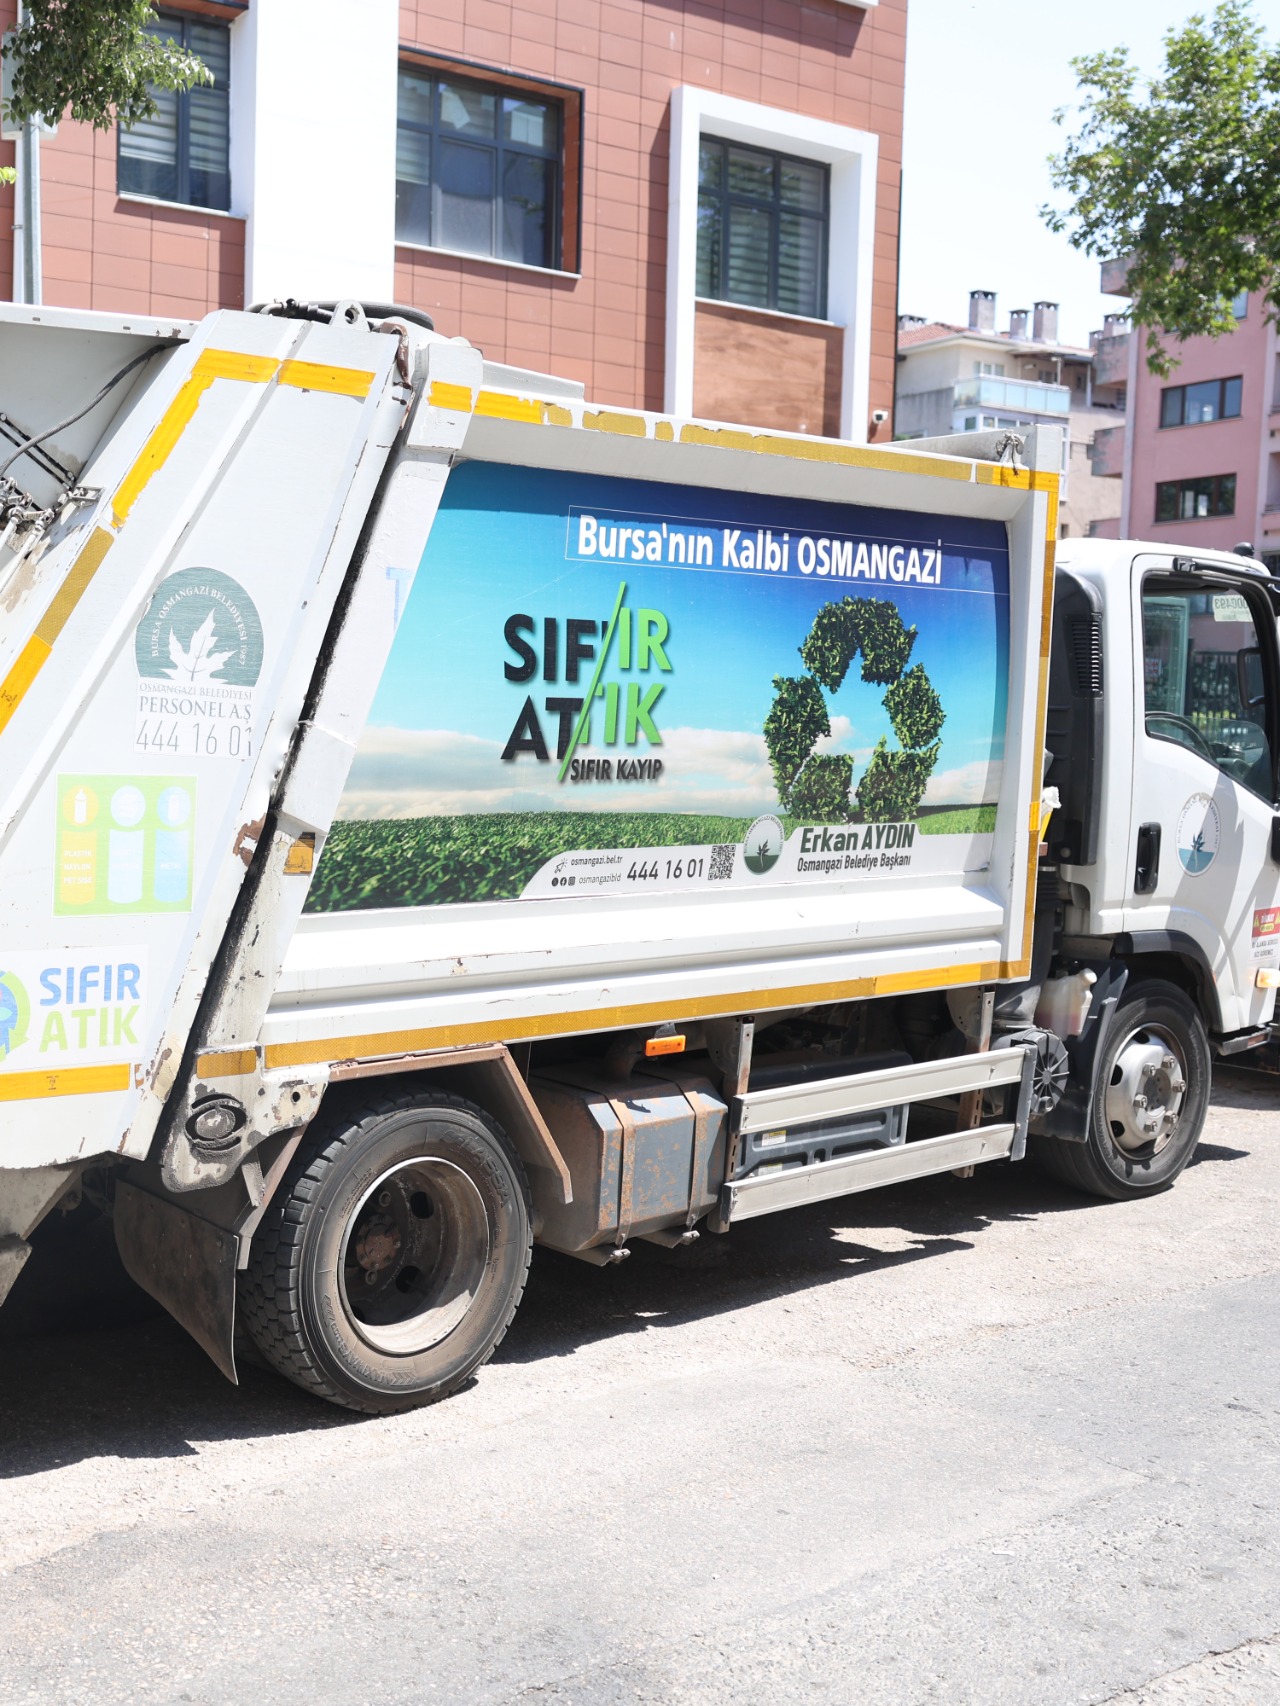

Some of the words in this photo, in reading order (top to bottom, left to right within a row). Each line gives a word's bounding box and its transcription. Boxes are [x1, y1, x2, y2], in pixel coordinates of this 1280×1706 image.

[578, 515, 713, 566] Bursa'nın
[722, 529, 789, 571] Kalbi
[797, 536, 942, 584] OSMANGAZİ
[151, 622, 162, 657] BURSA
[504, 607, 672, 682] SIFIR
[139, 683, 196, 696] OSMANGAZİ
[140, 696, 225, 718] PERSONEL
[500, 682, 665, 760] ATIK
[136, 719, 179, 752] 444
[192, 723, 217, 755] 16
[570, 758, 612, 781] SIFIR
[616, 758, 664, 780] KAYIP
[800, 827, 859, 853] Erkan
[861, 823, 916, 851] AYDIN
[570, 855, 622, 868] osmangazi.bel.tr
[627, 861, 658, 881] 444
[666, 859, 682, 880] 16
[687, 858, 704, 879] 01
[797, 856, 843, 874] Osmangazi
[844, 853, 878, 872] Belediye
[880, 852, 911, 870] Başkanı
[39, 962, 141, 1007] SIFIR
[39, 1004, 140, 1053] ATIK
